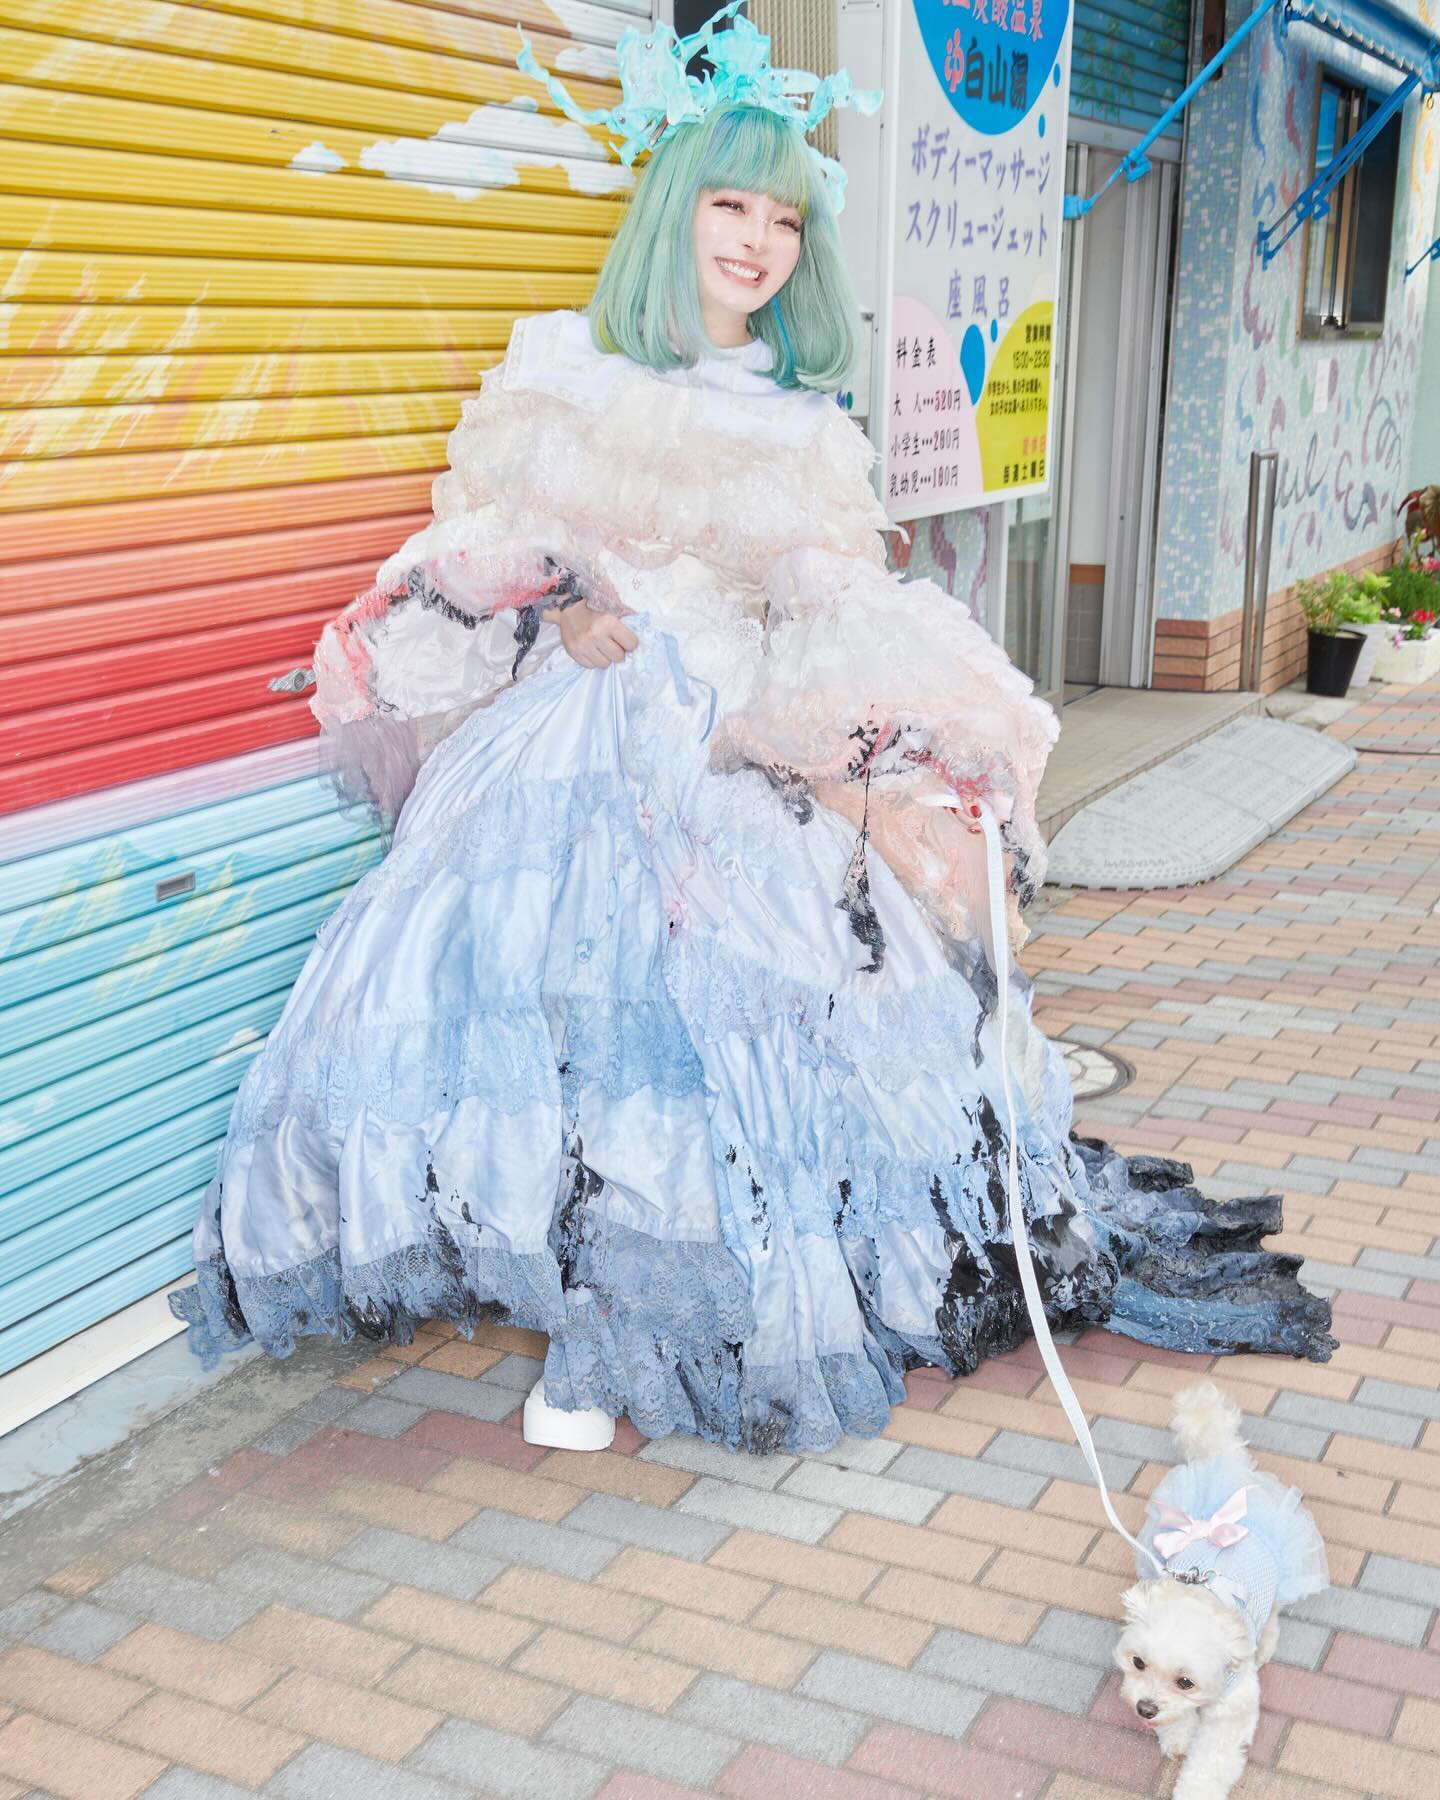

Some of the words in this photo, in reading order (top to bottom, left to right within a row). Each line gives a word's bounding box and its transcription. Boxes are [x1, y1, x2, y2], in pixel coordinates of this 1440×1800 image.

[912, 121, 1050, 194] ボディーマッサージ
[905, 199, 1048, 257] スクリュージェット
[946, 268, 1010, 319] 座風呂
[896, 336, 936, 368] 料金表
